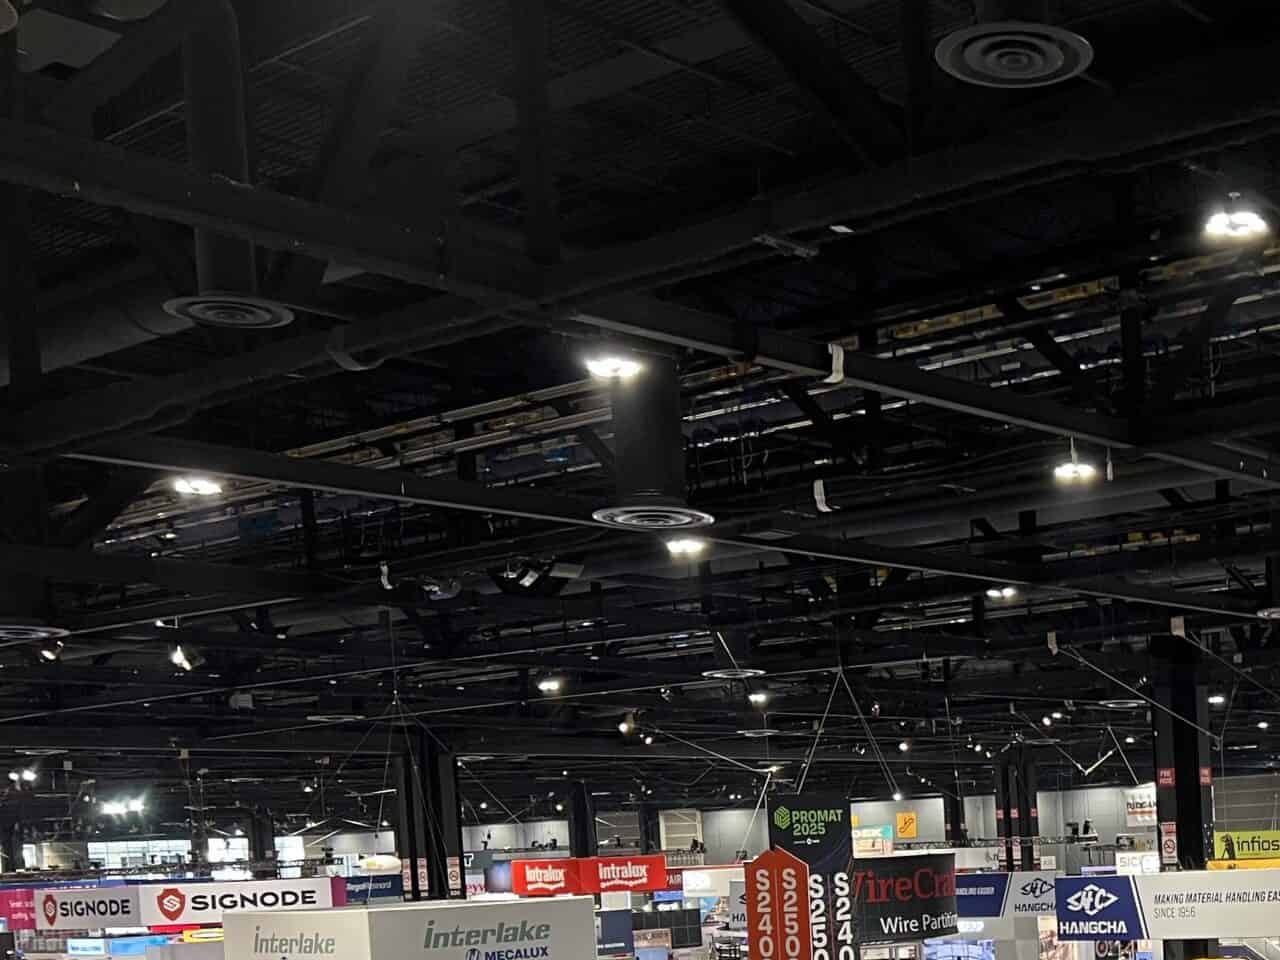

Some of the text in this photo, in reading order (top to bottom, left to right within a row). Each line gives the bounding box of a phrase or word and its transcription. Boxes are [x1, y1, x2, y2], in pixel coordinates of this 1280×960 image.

[791, 808, 843, 823] PROMAT
[793, 822, 826, 836] 2025
[1236, 834, 1280, 852] infios
[191, 889, 317, 911] SIGNODE
[1154, 892, 1184, 905] MAKING
[1185, 890, 1223, 904] MATERIAL
[1225, 890, 1266, 903] HANDLING
[60, 899, 131, 917] SIGNODE
[1153, 907, 1176, 919] SINCE
[880, 915, 920, 935] Wire
[1059, 919, 1128, 935] HANGCHA
[254, 926, 336, 954] interlake
[424, 920, 551, 949] interlake
